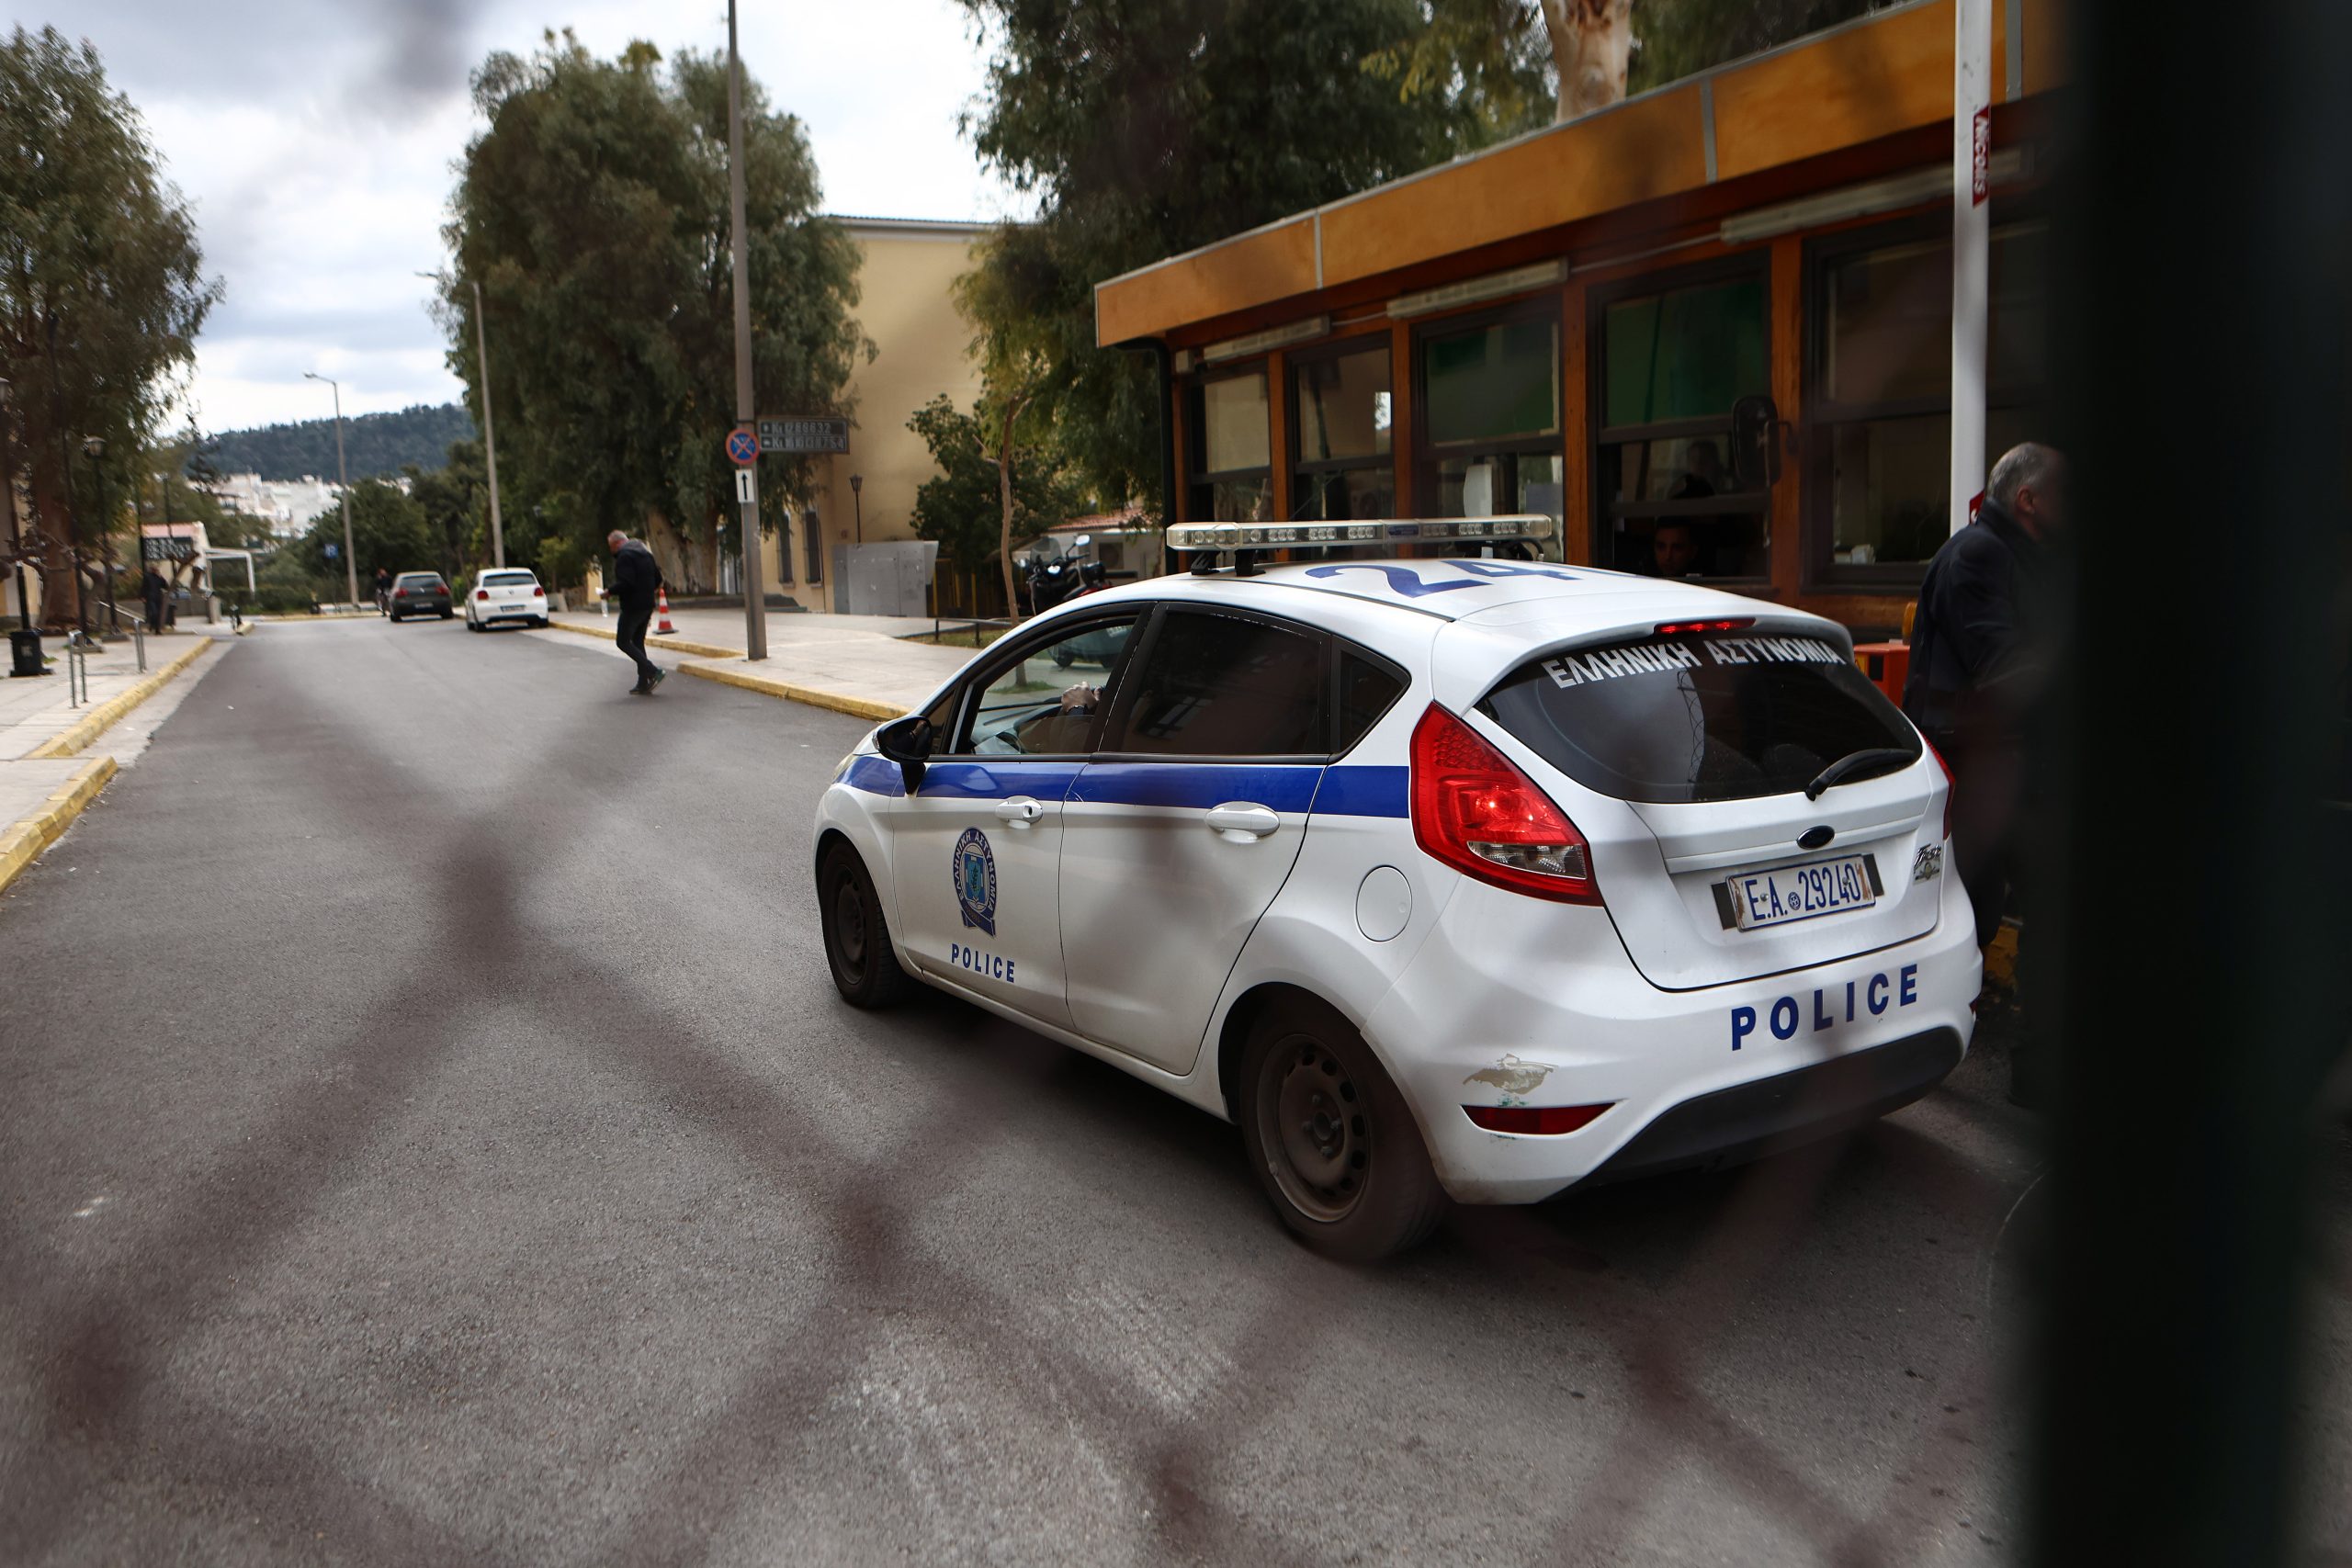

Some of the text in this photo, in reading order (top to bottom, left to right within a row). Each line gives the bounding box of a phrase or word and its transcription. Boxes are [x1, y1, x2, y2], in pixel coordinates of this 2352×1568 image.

[1541, 637, 1848, 689] ΕΛΛΗΝΙΚΗ ΑΣΤΥΝΟΜΙΑ
[951, 942, 1015, 984] POLICE
[1731, 964, 1917, 1051] POLICE
